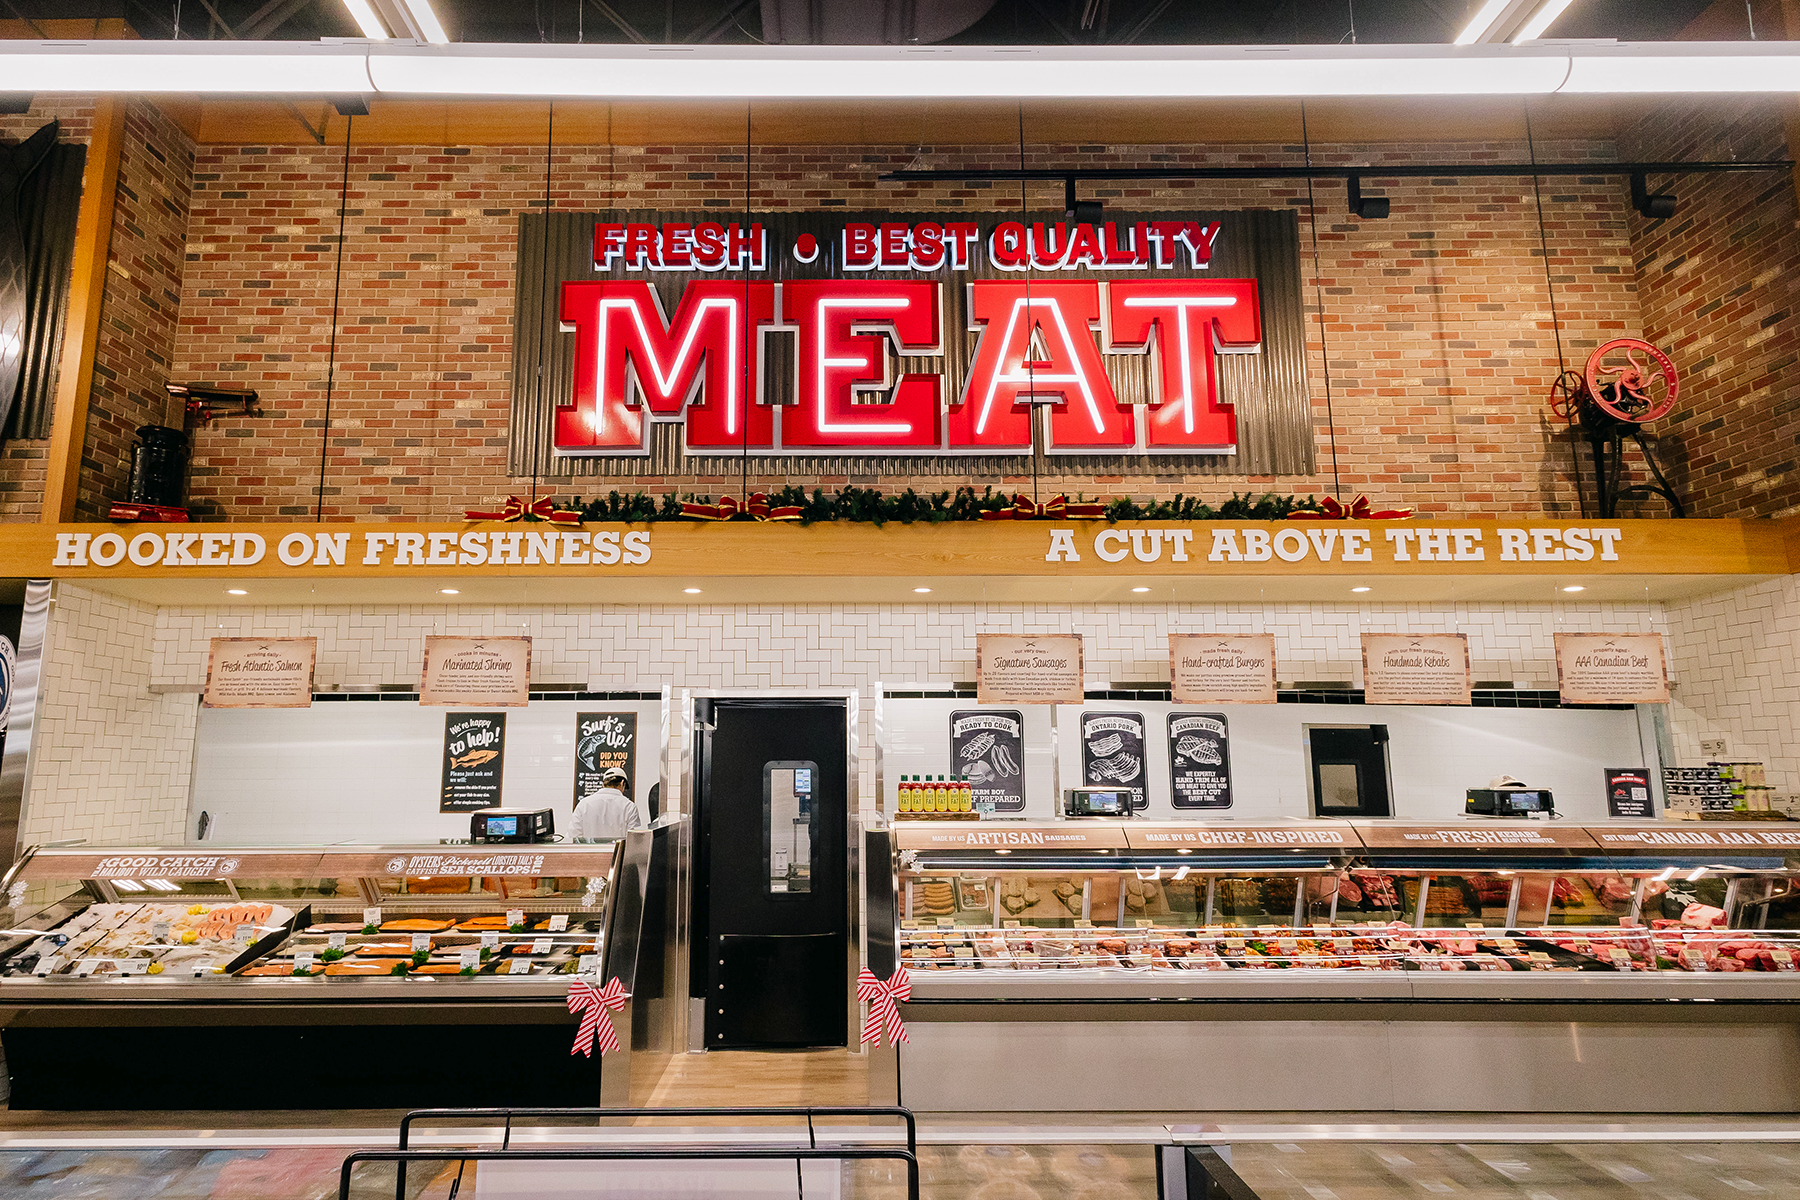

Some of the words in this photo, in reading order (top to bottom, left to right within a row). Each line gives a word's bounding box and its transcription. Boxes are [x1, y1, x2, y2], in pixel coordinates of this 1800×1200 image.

[595, 222, 767, 272] FRESH
[842, 222, 977, 272] BEST
[989, 221, 1220, 271] QUALITY
[554, 279, 1261, 457] MEAT
[52, 533, 265, 567] HOOKED
[277, 532, 348, 566] ON
[362, 531, 652, 566] FRESHNESS
[1045, 529, 1081, 562] A
[1094, 528, 1194, 562] CUT
[1207, 528, 1373, 562] ABOVE
[1385, 528, 1485, 562] THE
[1499, 528, 1622, 562] REST
[221, 660, 241, 672] Fresh
[242, 660, 274, 672] Atlantic
[275, 660, 303, 672] Salmon
[442, 659, 483, 671] Marinated
[484, 659, 512, 672] Shrimp
[994, 657, 1031, 670] Signature
[1032, 657, 1067, 670] Sausages
[1182, 656, 1234, 669] Hand-crafted
[1235, 656, 1265, 670] Burgers
[1384, 656, 1423, 668] Handmade
[1424, 656, 1450, 668] Kebabs
[1576, 656, 1592, 668] AAA
[1594, 656, 1630, 668] Canadian
[1630, 655, 1649, 668] Beef
[449, 722, 470, 735] We're
[469, 719, 492, 728] happy
[581, 716, 626, 736] Surf's
[960, 722, 982, 731] READY
[994, 722, 1013, 731] COOK
[1092, 723, 1117, 731] ONTARIO
[1118, 724, 1134, 732] PORK
[1176, 723, 1204, 731] CANADIAN
[449, 740, 466, 756] to
[468, 727, 500, 749] help!
[606, 732, 632, 748] Up!
[600, 760, 626, 768] KNOW?
[966, 833, 1044, 844] ARTISAN
[1146, 834, 1172, 842] MADE
[1172, 834, 1183, 842] BY
[1184, 834, 1196, 842] US
[1198, 831, 1344, 844] CHEF-INSPIRED
[1436, 830, 1502, 843] FRESH
[1637, 832, 1720, 844] CANADA
[1718, 832, 1762, 844] AAA
[106, 857, 159, 868] GOOD
[160, 857, 219, 868] CATCH
[409, 856, 443, 868] OYSTERS
[492, 856, 518, 866] LOBSTER
[518, 856, 534, 866] TAILS
[98, 867, 138, 877] HALIBUT
[138, 867, 168, 877] WILD
[168, 867, 214, 877] CAUGHT
[439, 866, 465, 874] SEA
[465, 866, 532, 874] SCALLOPS
